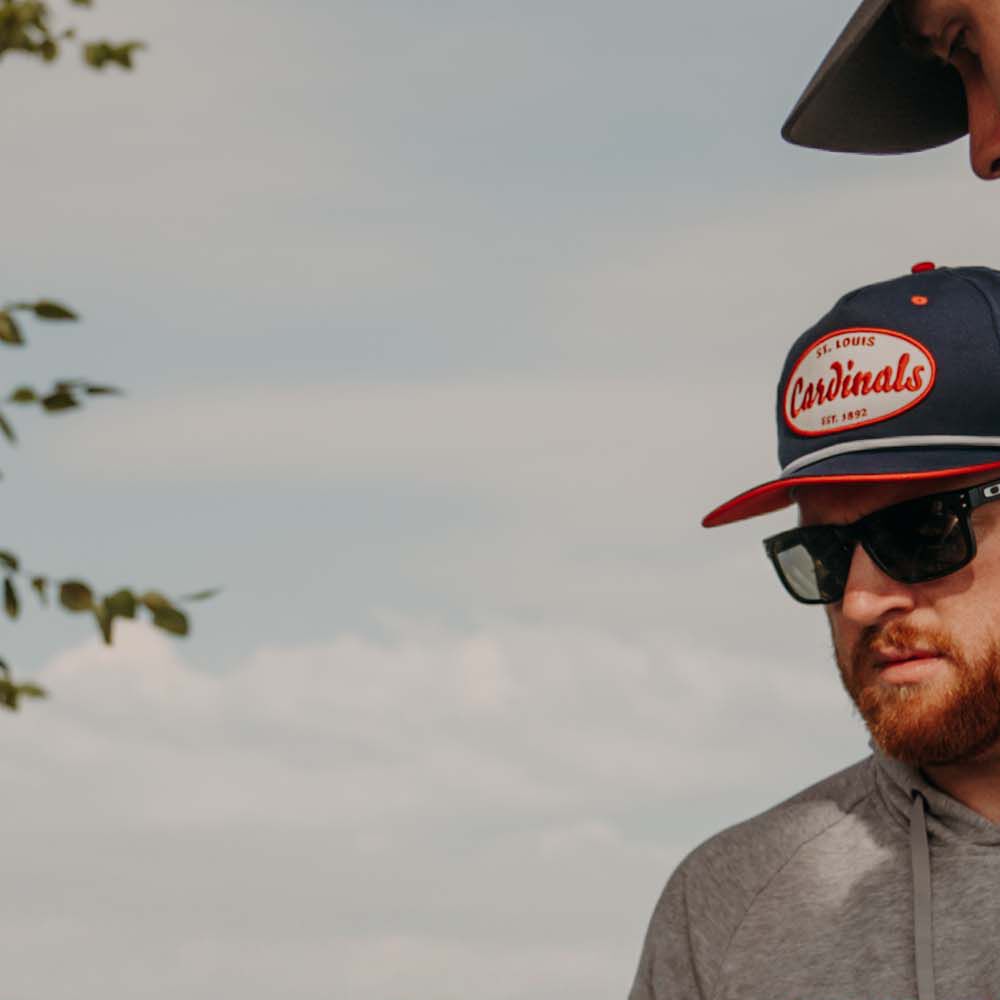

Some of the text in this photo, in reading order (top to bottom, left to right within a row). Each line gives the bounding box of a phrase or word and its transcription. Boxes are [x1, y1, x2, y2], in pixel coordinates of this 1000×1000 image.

[815, 336, 876, 358] ST. LOUIS
[790, 352, 925, 418] Cardinals
[821, 408, 868, 426] EST. 1892
